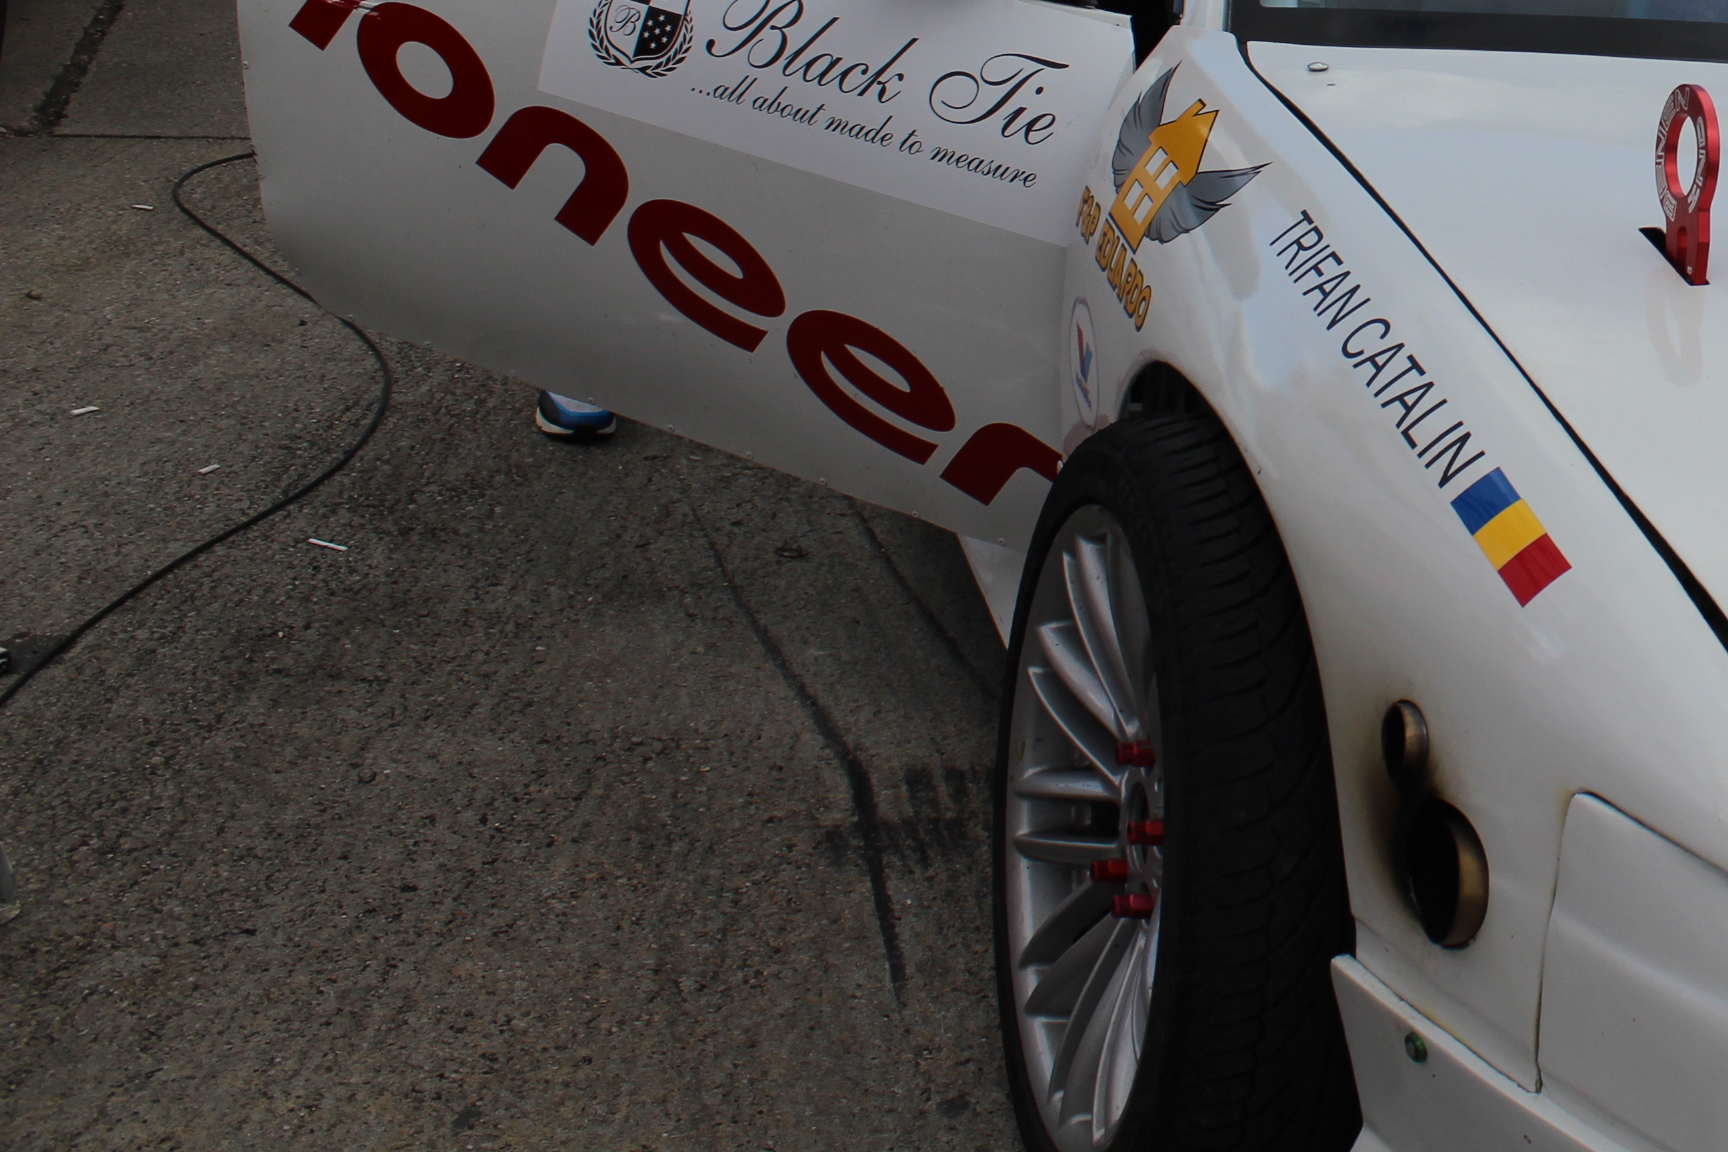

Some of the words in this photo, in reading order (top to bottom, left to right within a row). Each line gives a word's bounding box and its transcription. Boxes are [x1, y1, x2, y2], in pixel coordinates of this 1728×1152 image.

[751, 85, 825, 128] about
[825, 115, 893, 148] made
[899, 129, 924, 156] to
[930, 147, 1038, 188] measure
[929, 53, 1070, 146] Tie
[1095, 217, 1152, 333] EDUARDO
[1269, 209, 1371, 331] TRIFAN
[1341, 318, 1486, 489] CATALIN
